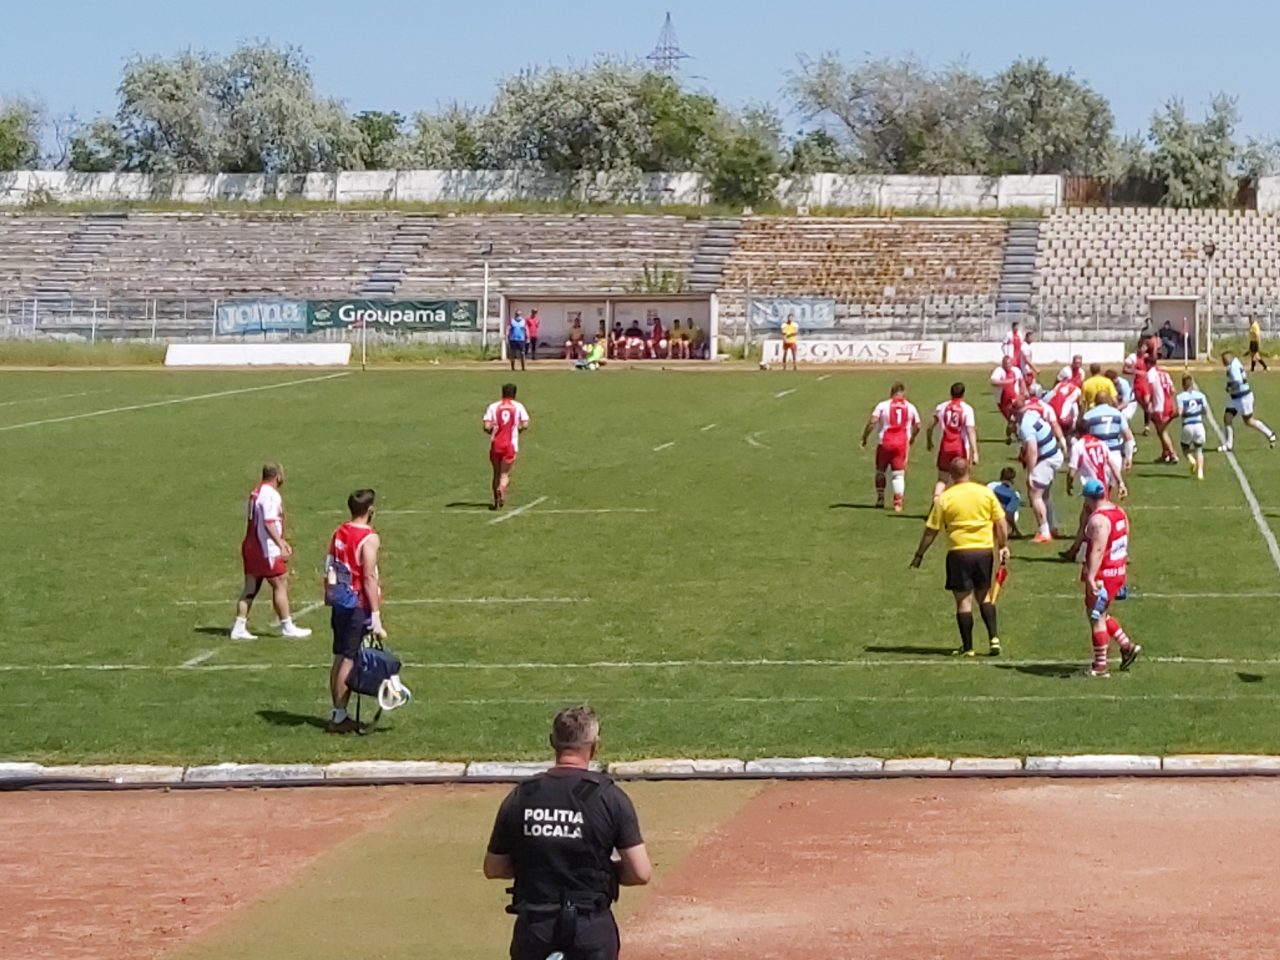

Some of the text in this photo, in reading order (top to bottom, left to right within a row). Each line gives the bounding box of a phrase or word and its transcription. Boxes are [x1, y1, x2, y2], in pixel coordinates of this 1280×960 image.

[338, 305, 446, 325] Groupama
[895, 408, 903, 425] 1
[1101, 416, 1113, 434] 7
[524, 809, 584, 823] POLITIA
